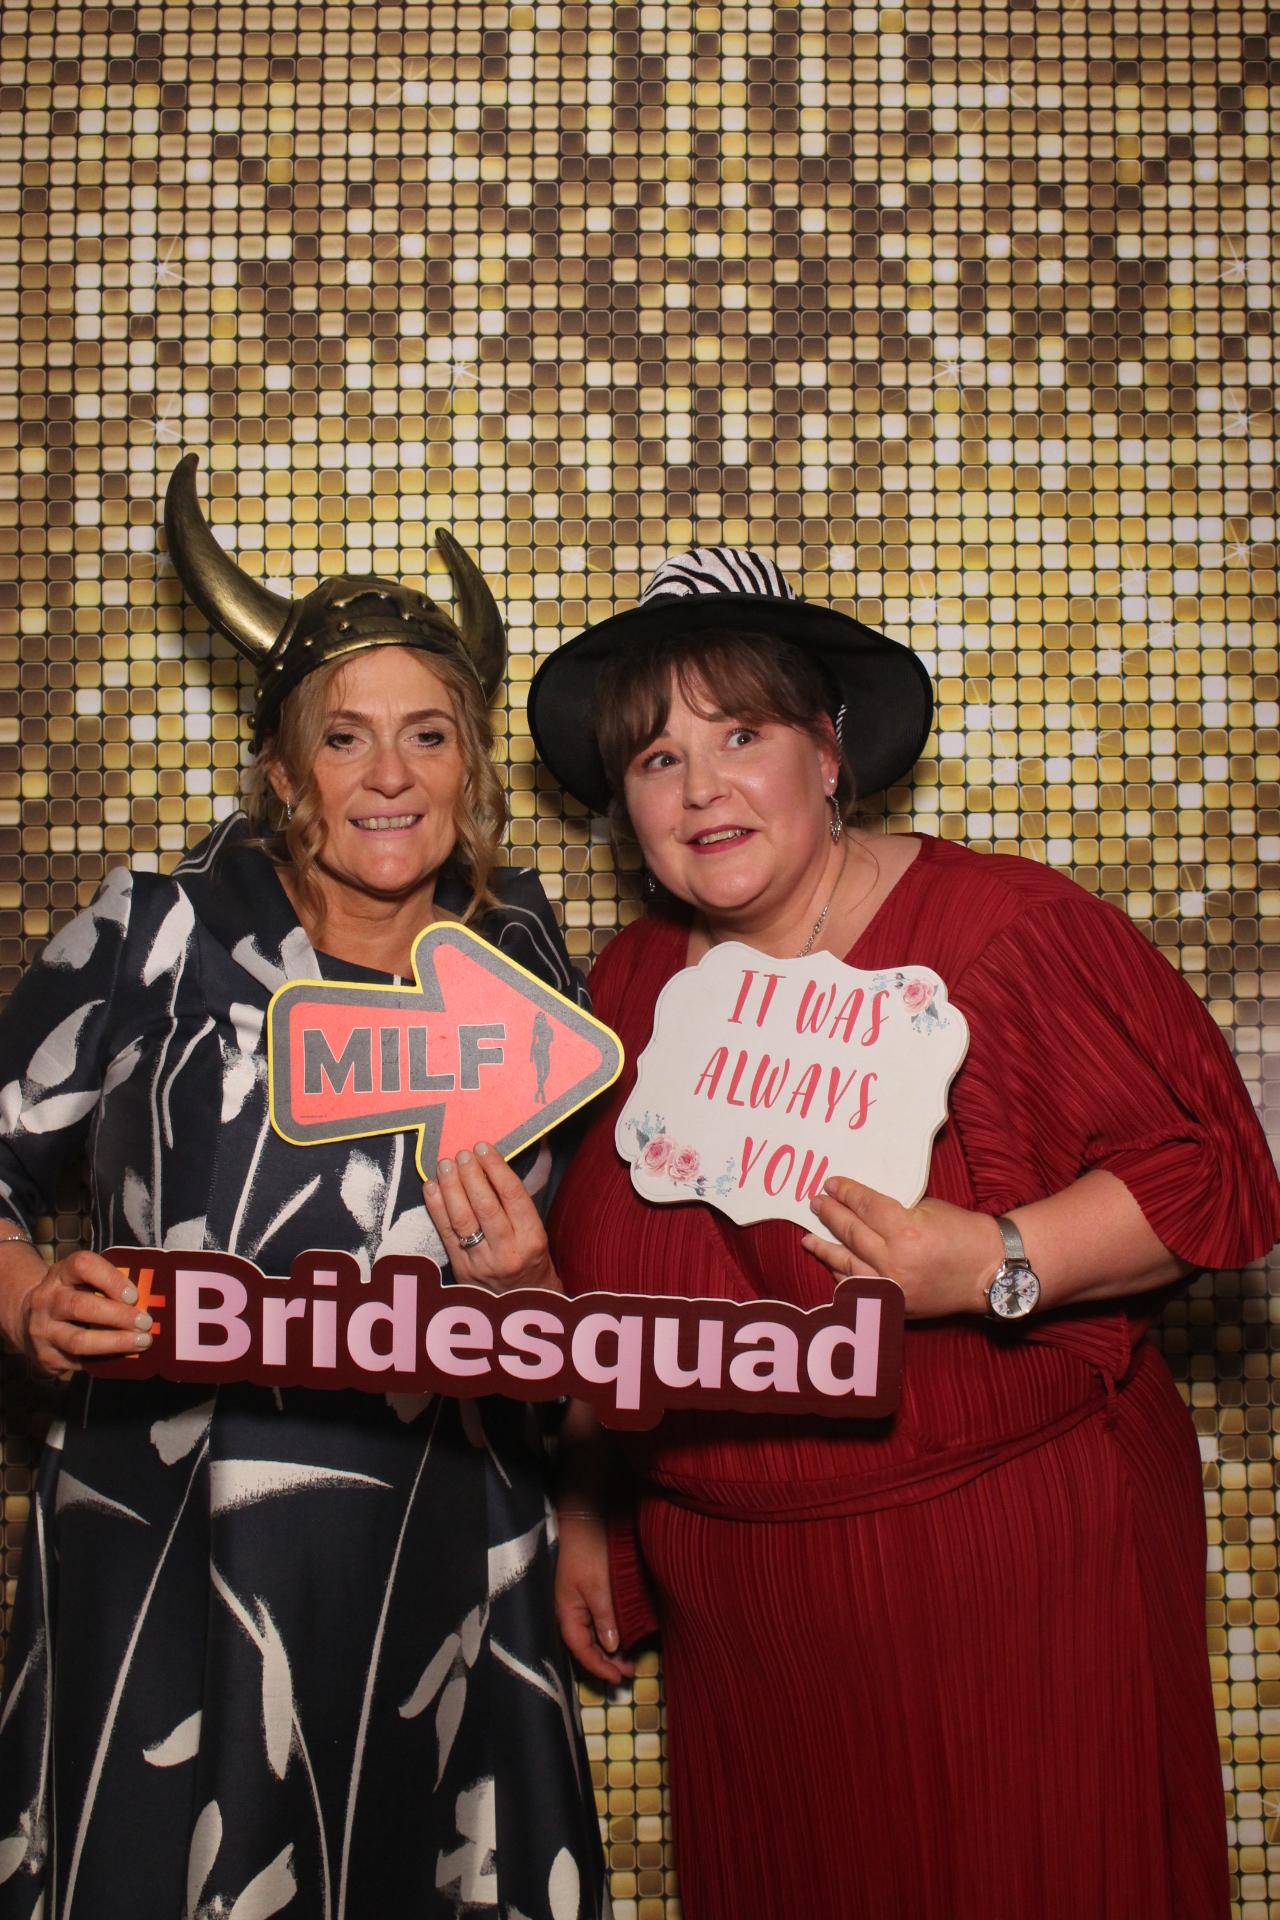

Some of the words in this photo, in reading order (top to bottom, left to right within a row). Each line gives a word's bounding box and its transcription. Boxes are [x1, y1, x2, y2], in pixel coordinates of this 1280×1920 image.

[727, 968, 787, 1028] IT
[795, 979, 890, 1047] WAS
[303, 1023, 507, 1095] MILF
[693, 1046, 878, 1131] ALWAYS
[738, 1136, 829, 1202] YOU
